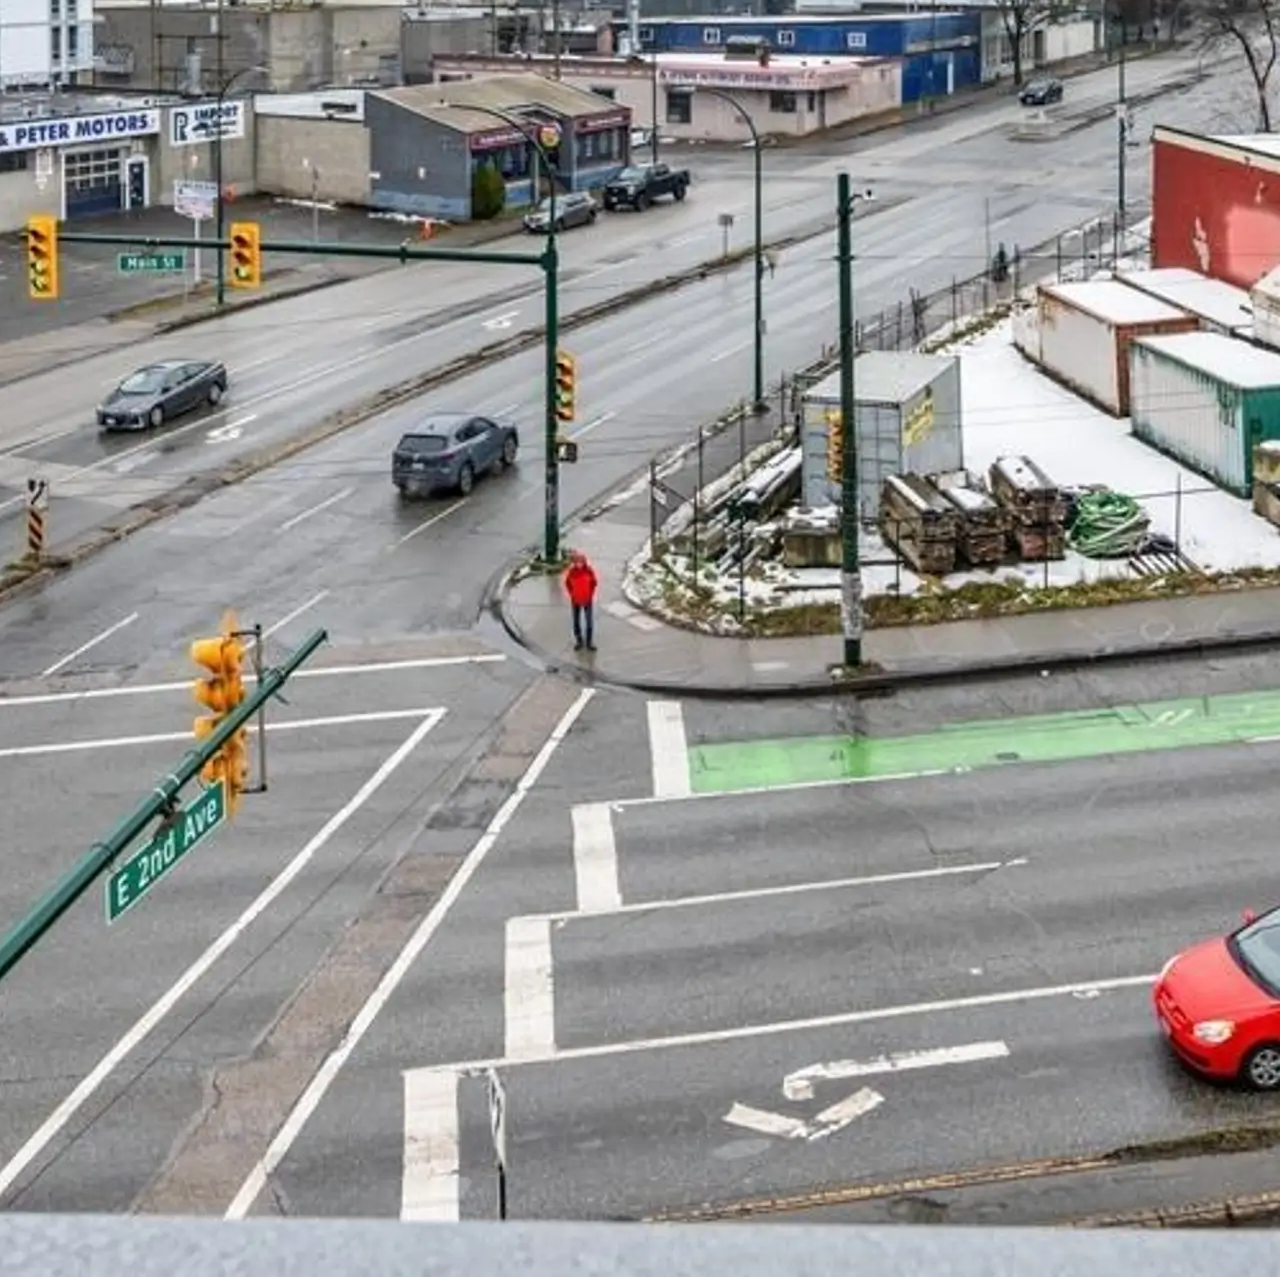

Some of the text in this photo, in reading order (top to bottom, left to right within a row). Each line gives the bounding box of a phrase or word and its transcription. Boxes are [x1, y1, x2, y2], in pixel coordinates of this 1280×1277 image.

[15, 121, 70, 147] PETER
[74, 113, 148, 138] MOTORS
[127, 256, 177, 271] Main St
[116, 798, 218, 907] E 2nd Ave
